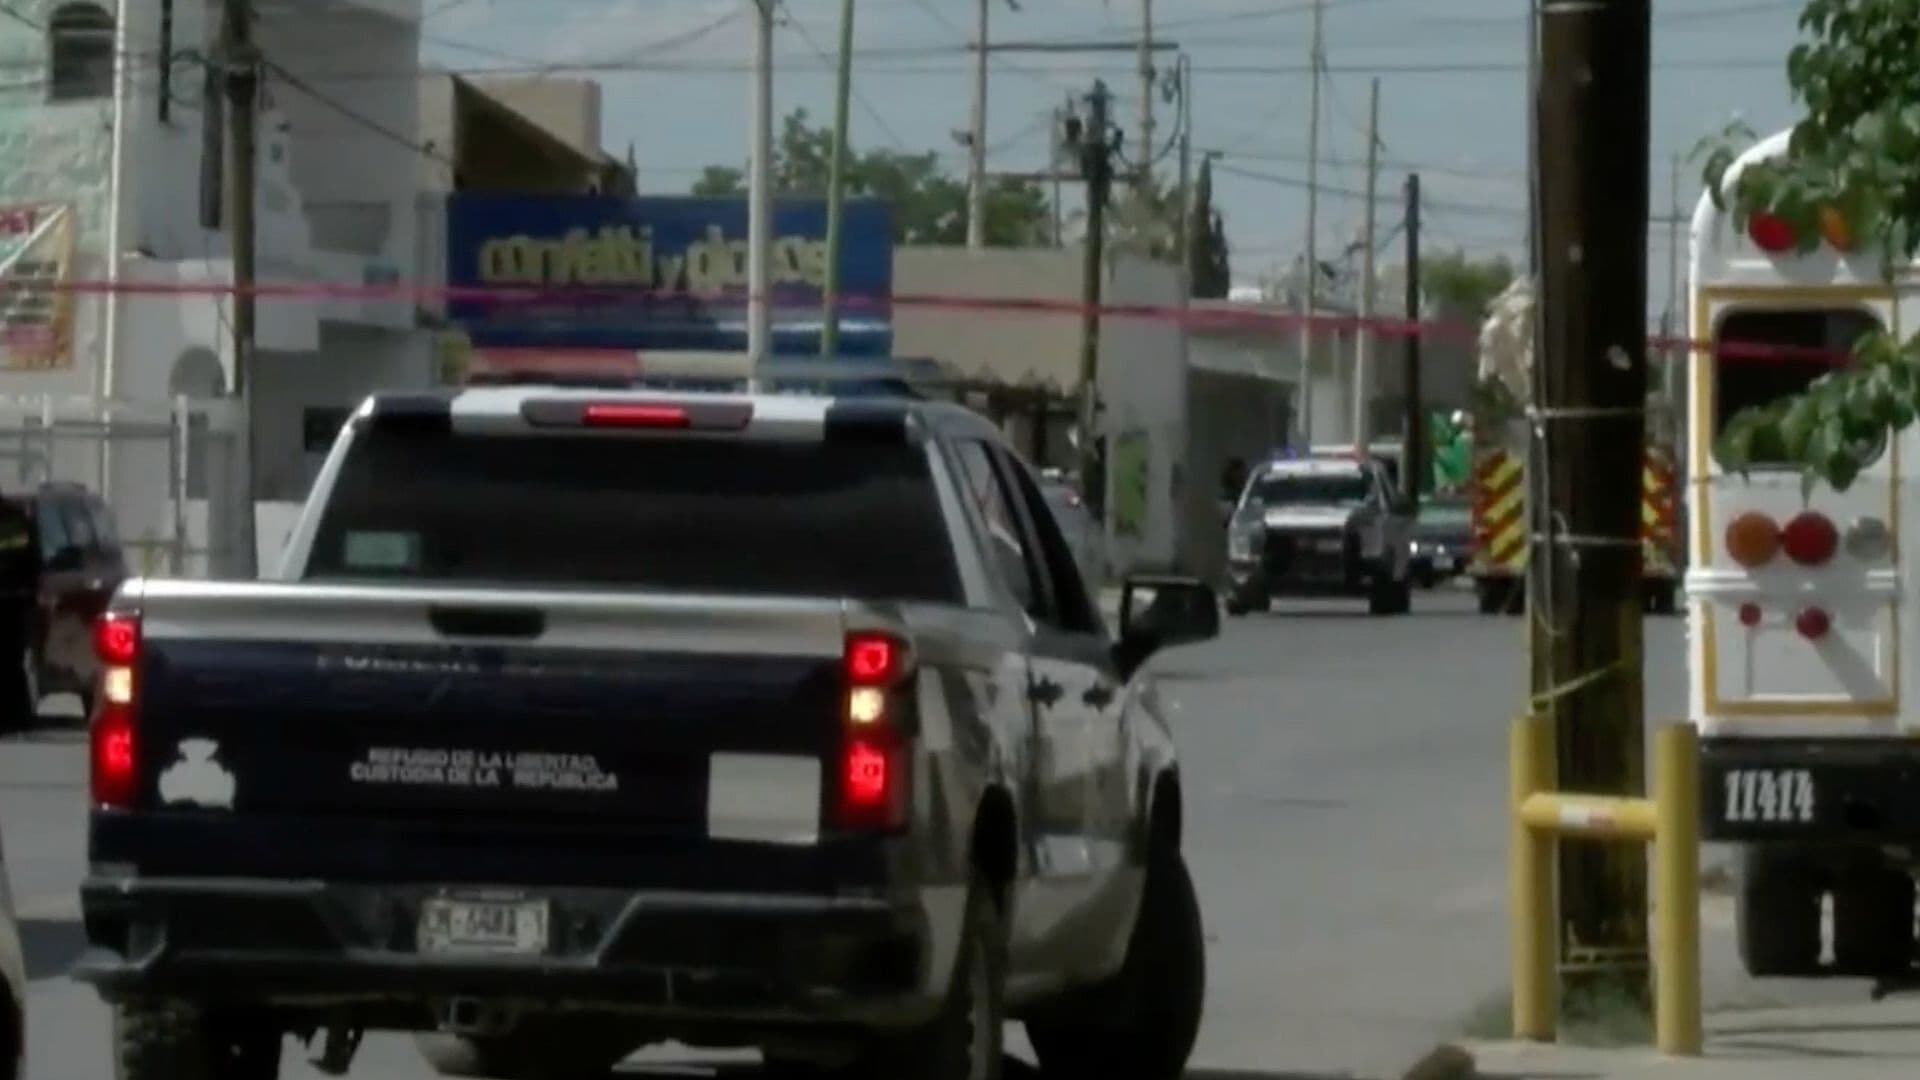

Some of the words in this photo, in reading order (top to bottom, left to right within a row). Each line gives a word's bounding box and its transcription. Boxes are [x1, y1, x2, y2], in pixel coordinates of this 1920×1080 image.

[368, 747, 448, 768] REFUGIO
[451, 748, 475, 769] DE
[478, 750, 502, 770] LA
[350, 761, 445, 782] CUSTODIA
[448, 765, 472, 784] DE
[475, 767, 500, 786] LA
[1724, 768, 1814, 821] 11414
